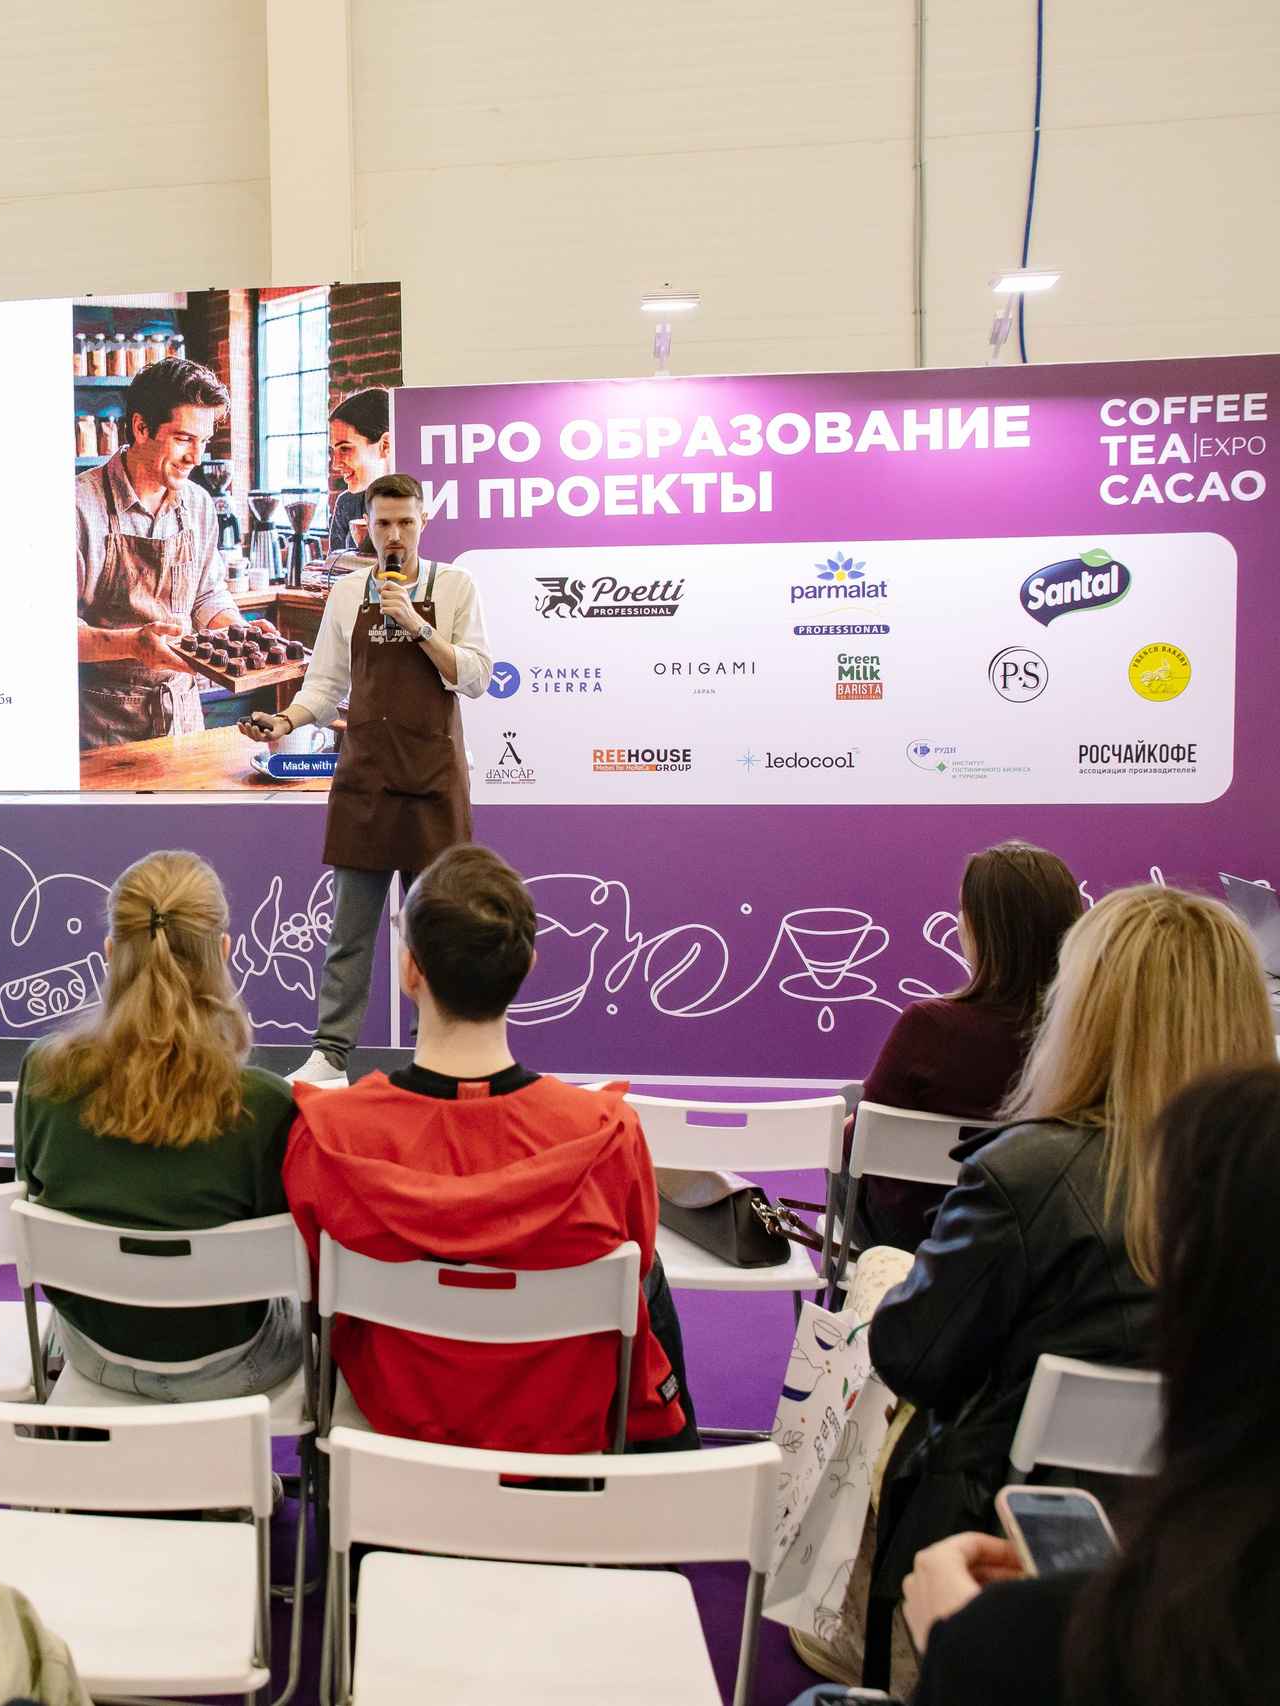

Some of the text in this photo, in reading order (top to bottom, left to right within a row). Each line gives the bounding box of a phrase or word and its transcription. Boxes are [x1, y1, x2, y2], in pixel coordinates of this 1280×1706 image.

[1100, 393, 1268, 427] COFFEE
[420, 405, 1031, 465] ПРО ОБРАЗОВАНИЕ
[1100, 433, 1266, 467] TEA EXPO
[421, 471, 772, 520] И ПРОЕКТЫ
[1099, 470, 1267, 506] CACAO
[591, 576, 685, 602] Poetti
[791, 580, 888, 604] parmalat
[1027, 564, 1119, 610] Santal
[593, 607, 672, 617] PROFESSIONAL
[798, 625, 886, 635] PROFESSIONAL
[837, 653, 881, 666] Green
[1132, 645, 1189, 668] FRENCH BAKERY
[654, 661, 755, 675] ORIGAMI
[838, 664, 881, 681] Milk
[532, 682, 603, 693] SIERRA
[837, 684, 882, 695] BARISTA
[592, 748, 692, 763] REEHOUSE
[1078, 739, 1198, 764] РОСЧАЙКОФЕ
[282, 761, 332, 771] Made with
[595, 764, 615, 773] Mebel
[615, 764, 624, 773] for
[655, 764, 692, 773] GROUP
[765, 752, 855, 769] ledocool
[1078, 765, 1197, 775] ассоциация производителей
